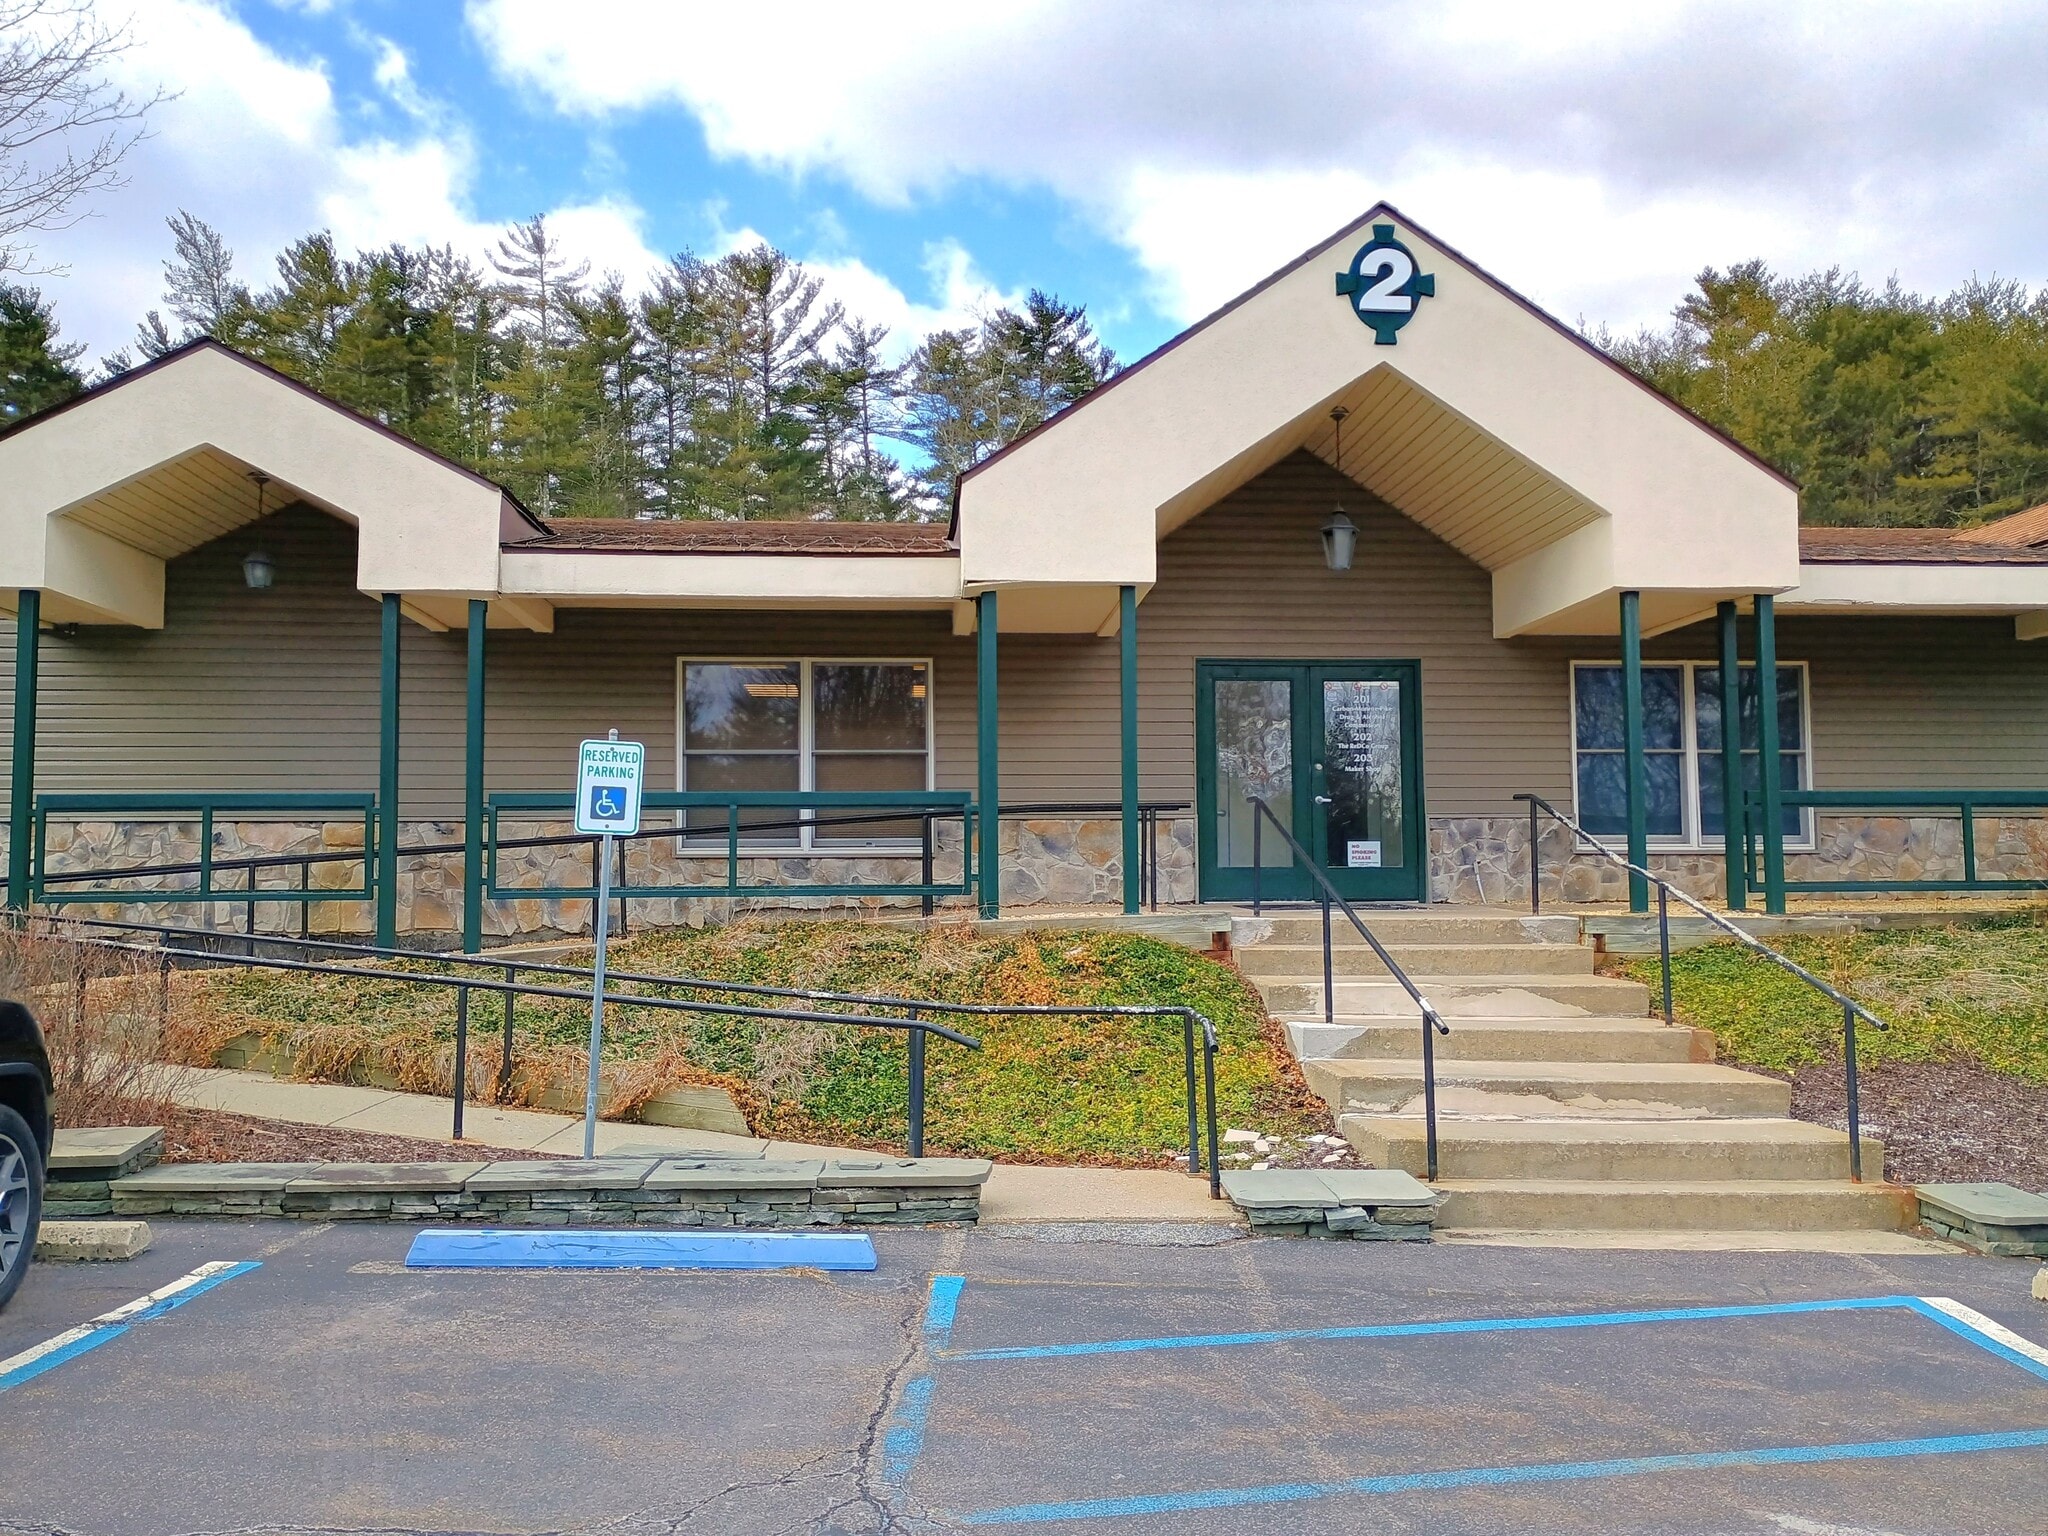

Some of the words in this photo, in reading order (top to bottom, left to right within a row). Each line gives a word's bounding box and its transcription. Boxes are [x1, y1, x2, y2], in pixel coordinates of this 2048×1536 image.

[1359, 247, 1413, 312] 2
[1353, 695, 1370, 703] 201
[1353, 732, 1372, 741] 202
[585, 749, 639, 764] RESERVED
[1353, 754, 1373, 762] 203
[587, 765, 634, 779] PARKING
